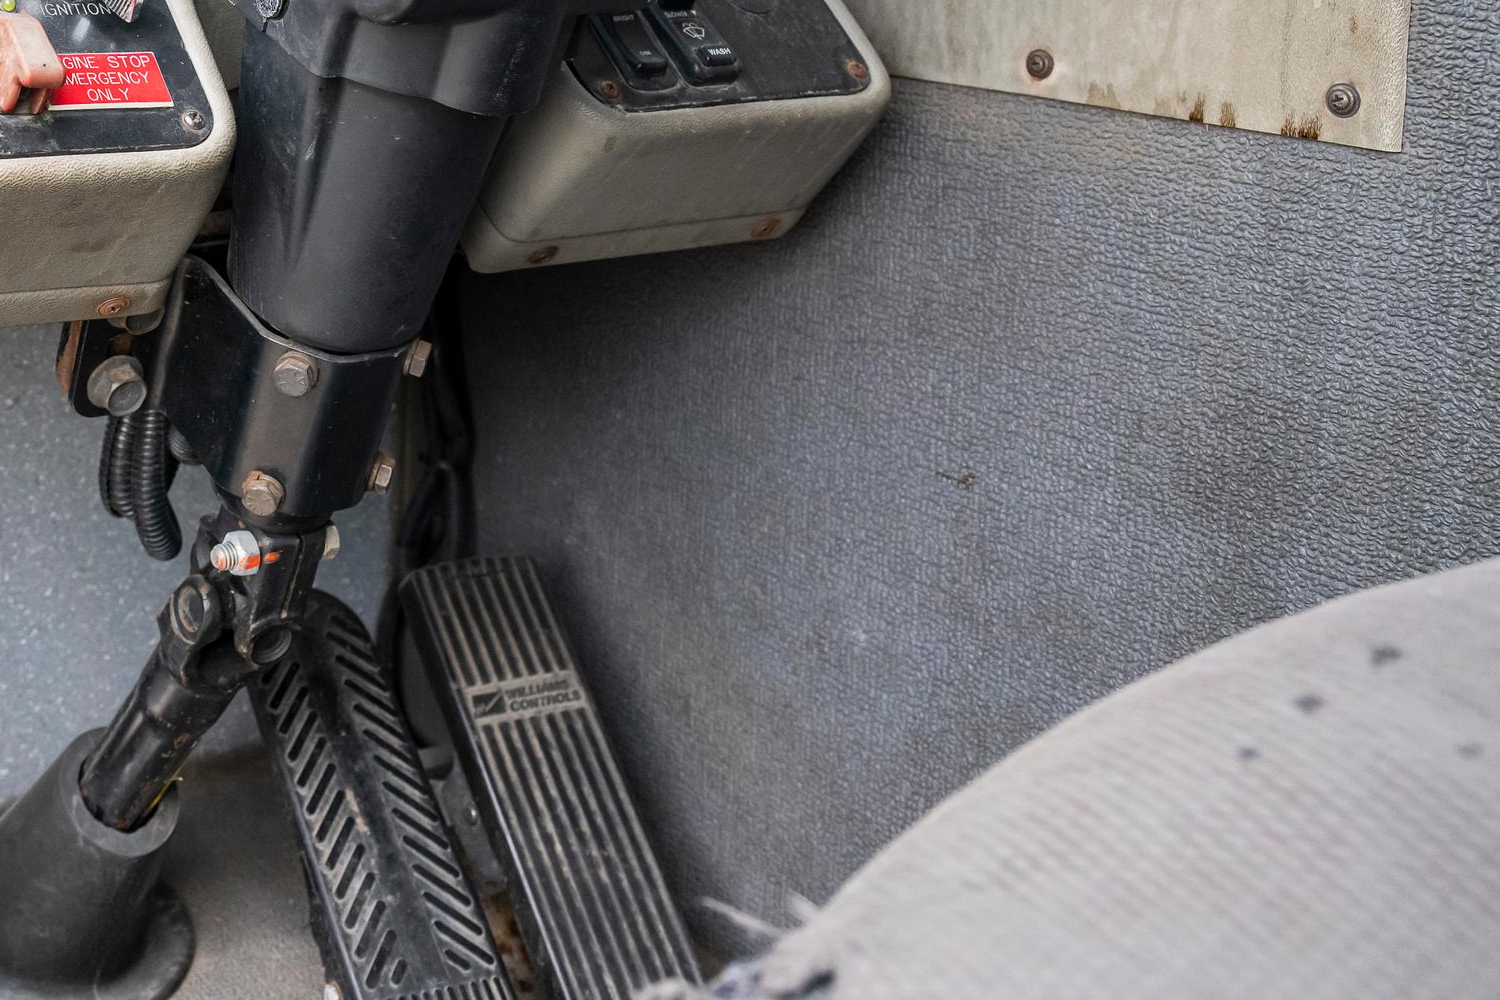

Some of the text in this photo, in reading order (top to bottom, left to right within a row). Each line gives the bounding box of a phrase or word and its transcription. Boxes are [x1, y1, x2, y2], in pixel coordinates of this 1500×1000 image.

[40, 3, 111, 17] IGNITION
[707, 47, 731, 56] WASH
[62, 56, 150, 69] GINE STOP
[64, 71, 149, 85] MERGENCY
[87, 88, 130, 101] ONLY
[510, 690, 580, 711] CONTROLS
